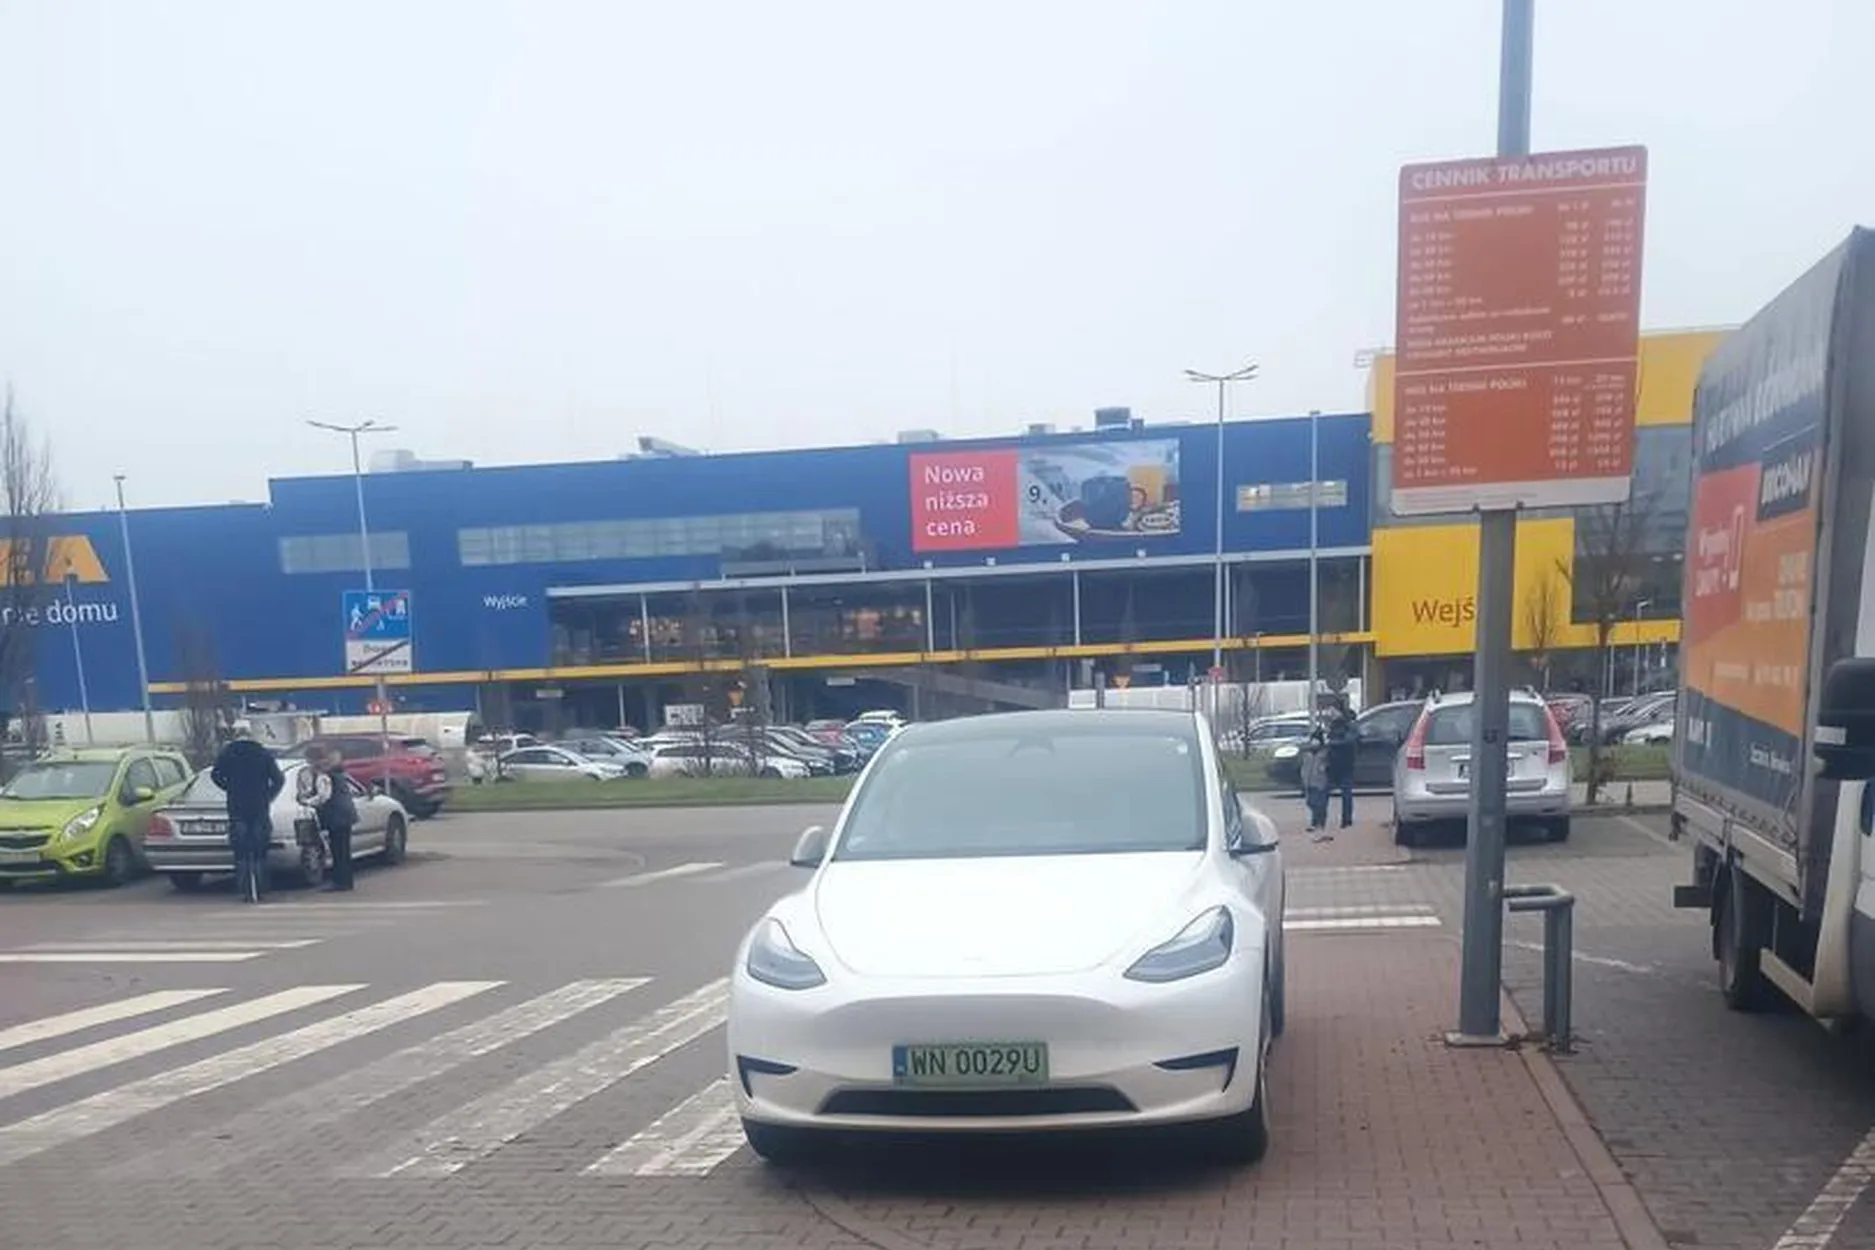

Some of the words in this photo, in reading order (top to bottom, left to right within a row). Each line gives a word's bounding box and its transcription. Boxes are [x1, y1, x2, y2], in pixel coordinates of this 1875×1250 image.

[1411, 167, 1490, 190] CENNIK
[1499, 155, 1637, 184] TRANSPORTU
[924, 464, 985, 485] Nowa
[925, 490, 989, 513] niższa
[926, 520, 977, 537] cena
[46, 600, 118, 624] domu
[483, 595, 528, 610] Wyjście
[1412, 596, 1475, 628] Wejś
[911, 1049, 946, 1075] WN
[956, 1048, 1040, 1075] 0029U
